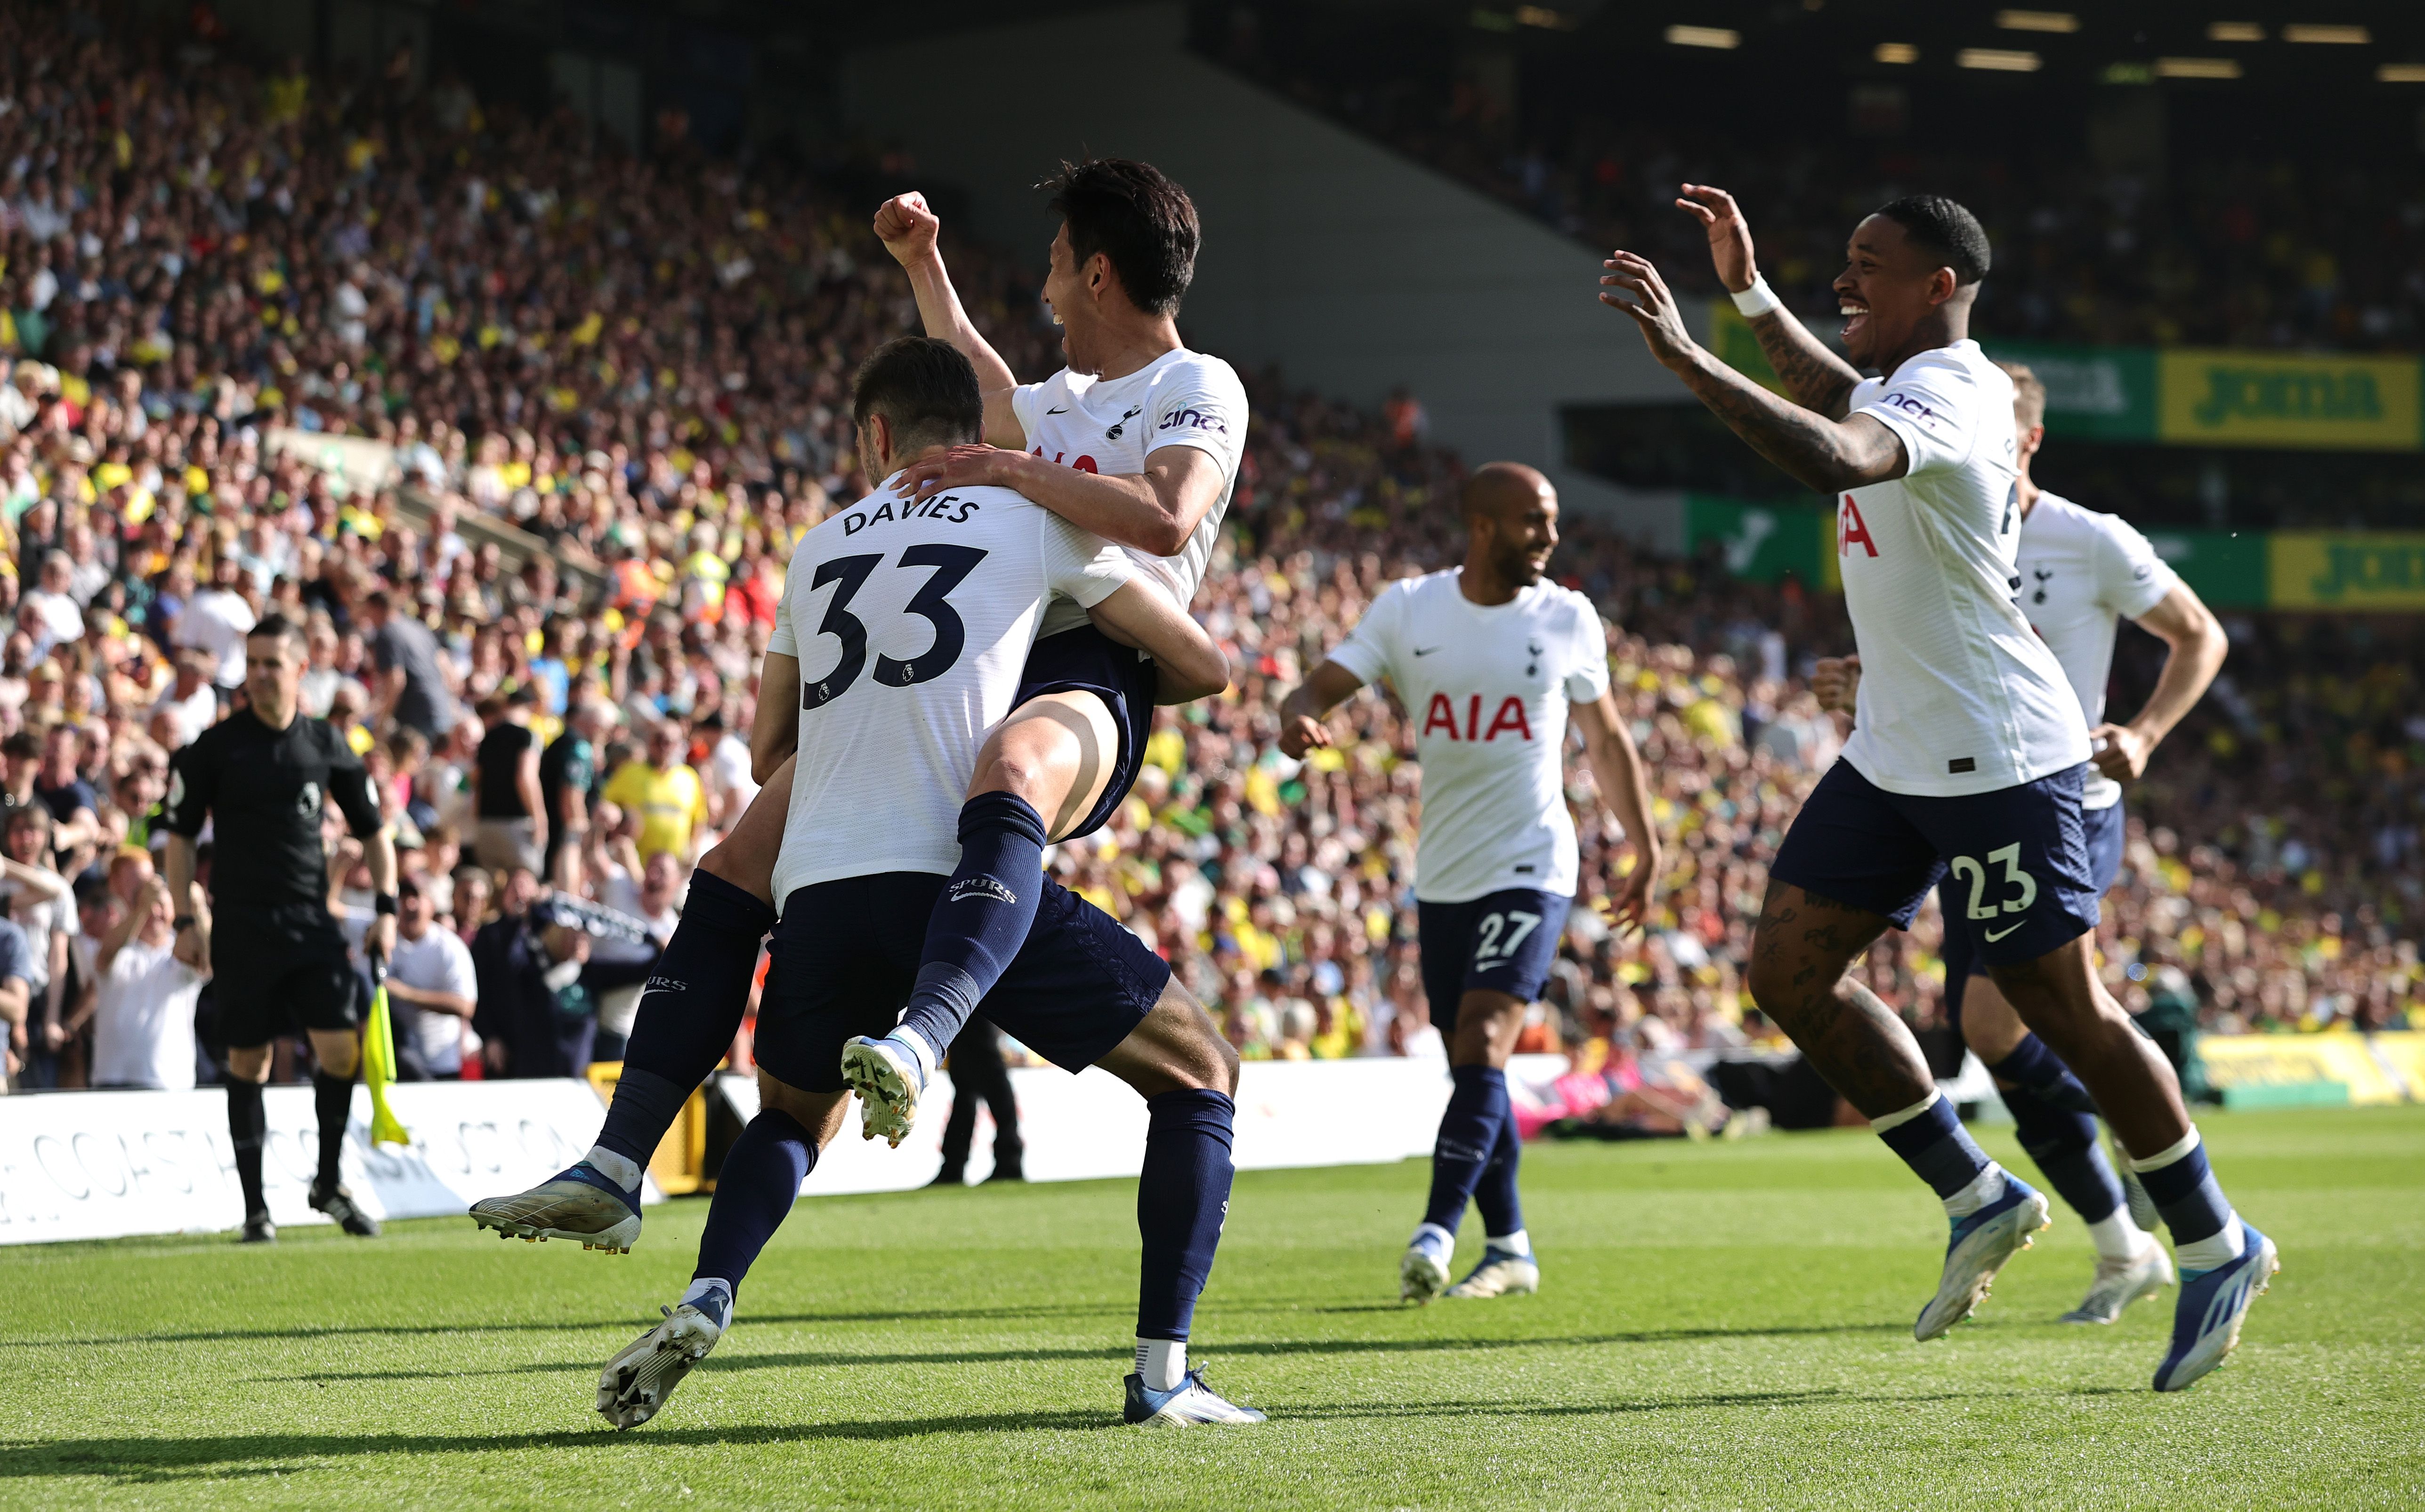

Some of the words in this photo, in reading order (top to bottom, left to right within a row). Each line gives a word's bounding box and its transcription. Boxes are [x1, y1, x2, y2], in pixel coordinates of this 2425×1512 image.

[843, 495, 980, 537] DAVIES
[802, 543, 989, 710] 33
[1423, 691, 1533, 742] AIA
[948, 879, 1017, 904] SPURS
[1951, 841, 2037, 920] 23
[1475, 909, 1542, 960] 27
[647, 976, 688, 991] URS
